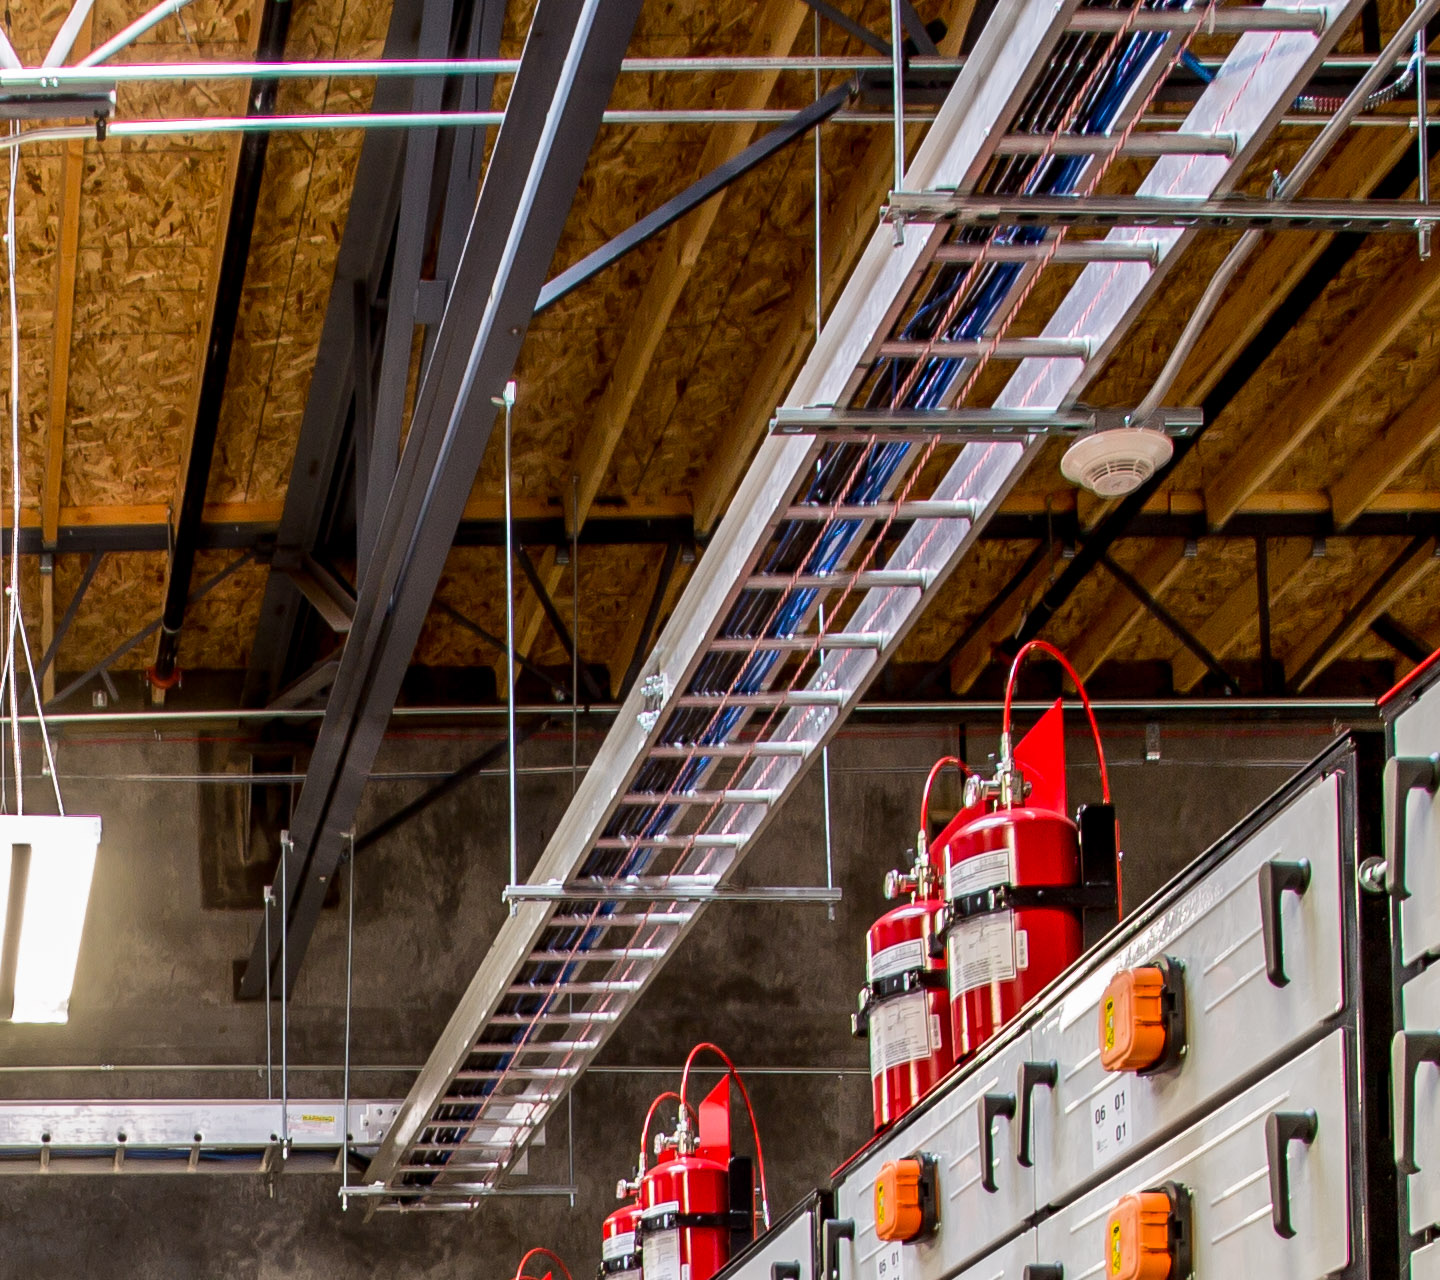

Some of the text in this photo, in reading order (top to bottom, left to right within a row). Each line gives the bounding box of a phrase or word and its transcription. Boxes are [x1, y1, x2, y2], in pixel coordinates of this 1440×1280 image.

[1114, 1090, 1125, 1111] 01
[1094, 1104, 1106, 1125] 06
[1115, 1121, 1126, 1142] 01
